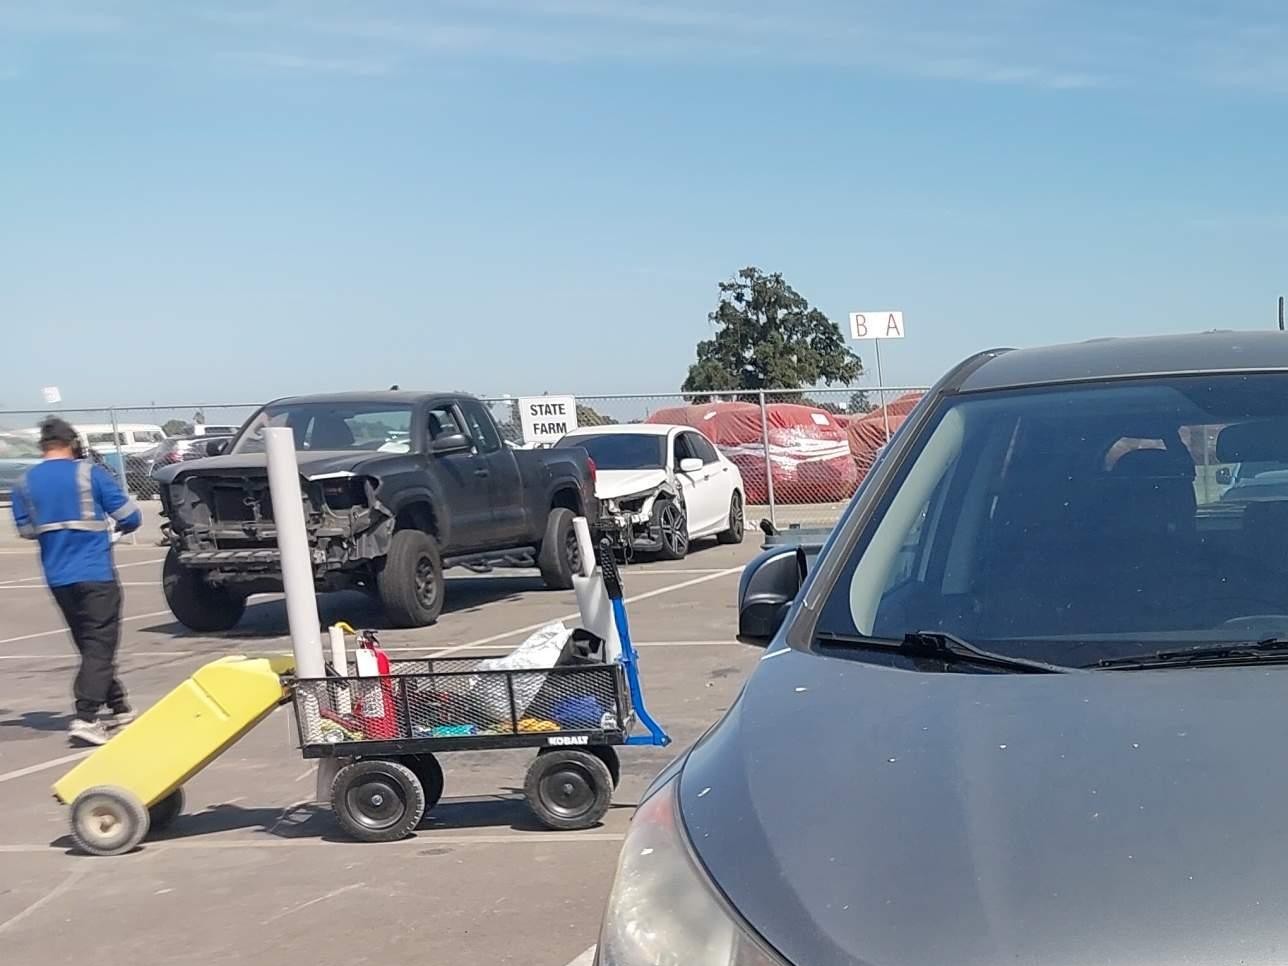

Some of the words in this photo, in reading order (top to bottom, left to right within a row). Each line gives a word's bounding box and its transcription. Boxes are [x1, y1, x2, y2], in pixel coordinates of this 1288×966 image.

[855, 314, 868, 337] B
[886, 313, 900, 337] A
[530, 403, 566, 416] STATE
[533, 422, 567, 435] FARM
[547, 736, 589, 746] KOBALT
